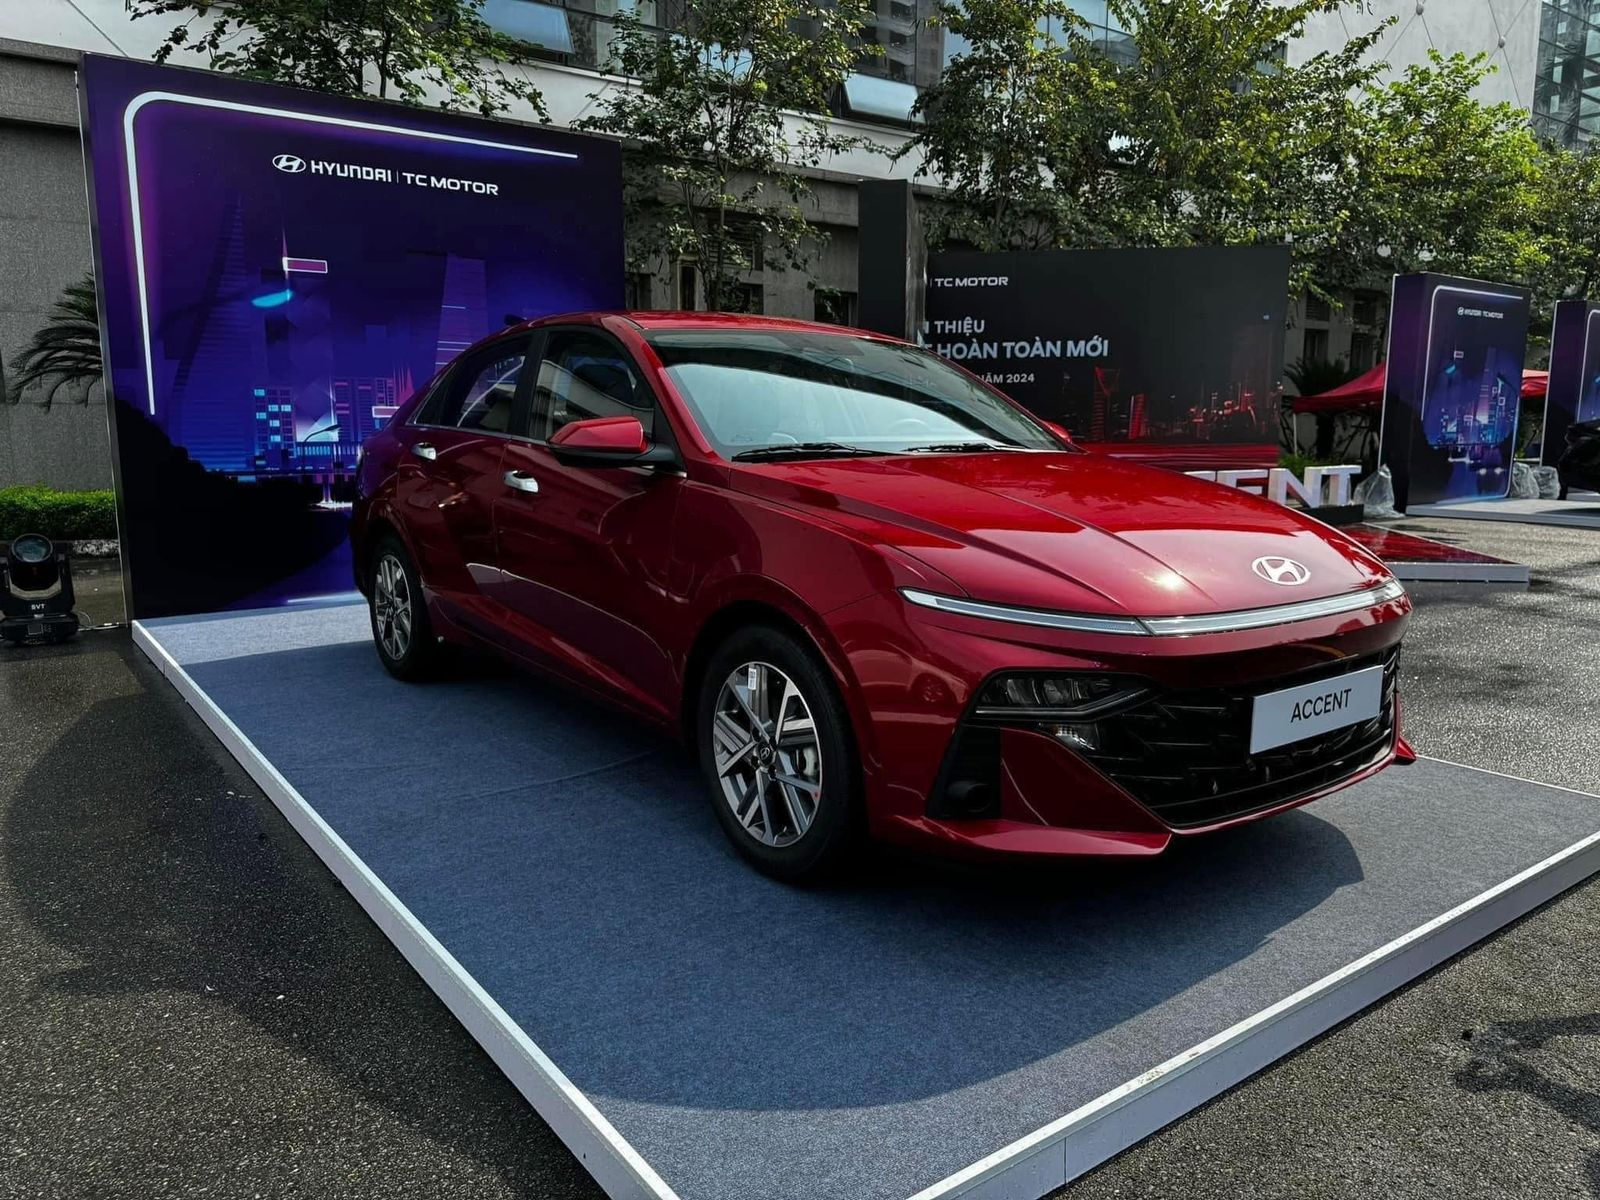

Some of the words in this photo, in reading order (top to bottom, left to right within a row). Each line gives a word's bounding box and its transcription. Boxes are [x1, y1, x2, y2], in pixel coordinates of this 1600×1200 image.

[310, 160, 392, 183] HYUNDAI
[402, 172, 428, 187] TC
[430, 176, 499, 196] MOTOR
[934, 277, 953, 287] TC
[954, 276, 1009, 287] MOTOR
[934, 316, 985, 336] THIỆU
[937, 338, 998, 360] HOÀN
[1002, 336, 1061, 360] TOÀN
[1066, 334, 1109, 358] MỚI
[1006, 372, 1035, 384] 2024
[1290, 687, 1352, 723] ACCENT
